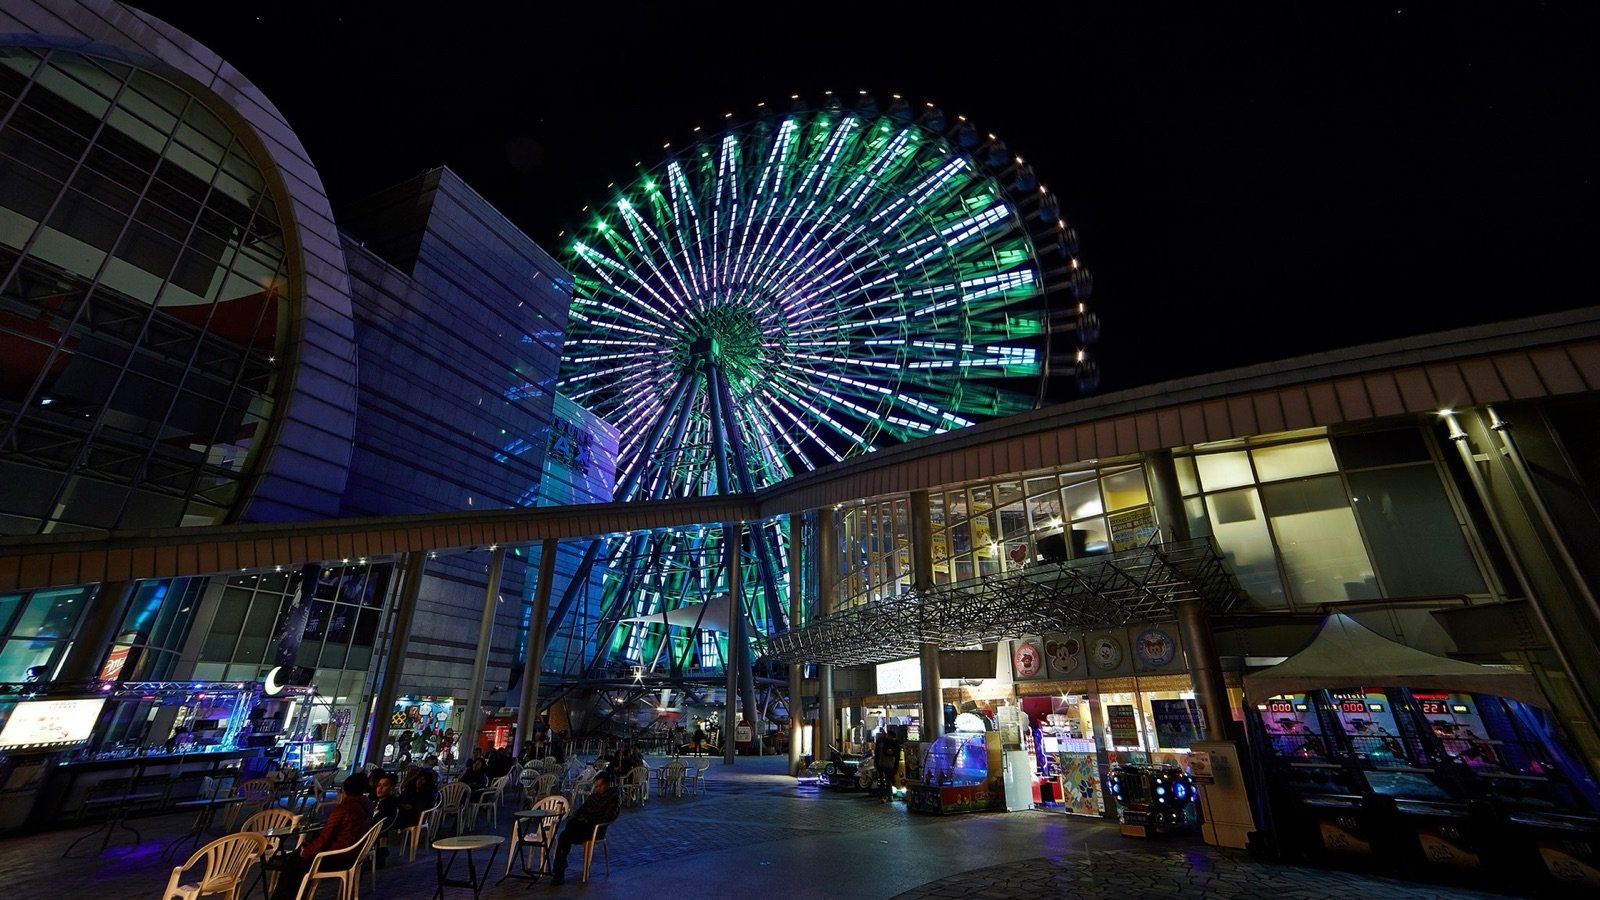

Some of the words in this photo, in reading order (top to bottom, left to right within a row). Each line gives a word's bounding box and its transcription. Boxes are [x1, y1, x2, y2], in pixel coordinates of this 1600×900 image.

[1272, 703, 1291, 712] 000
[1343, 703, 1364, 712] 000
[1423, 703, 1447, 713] 221
